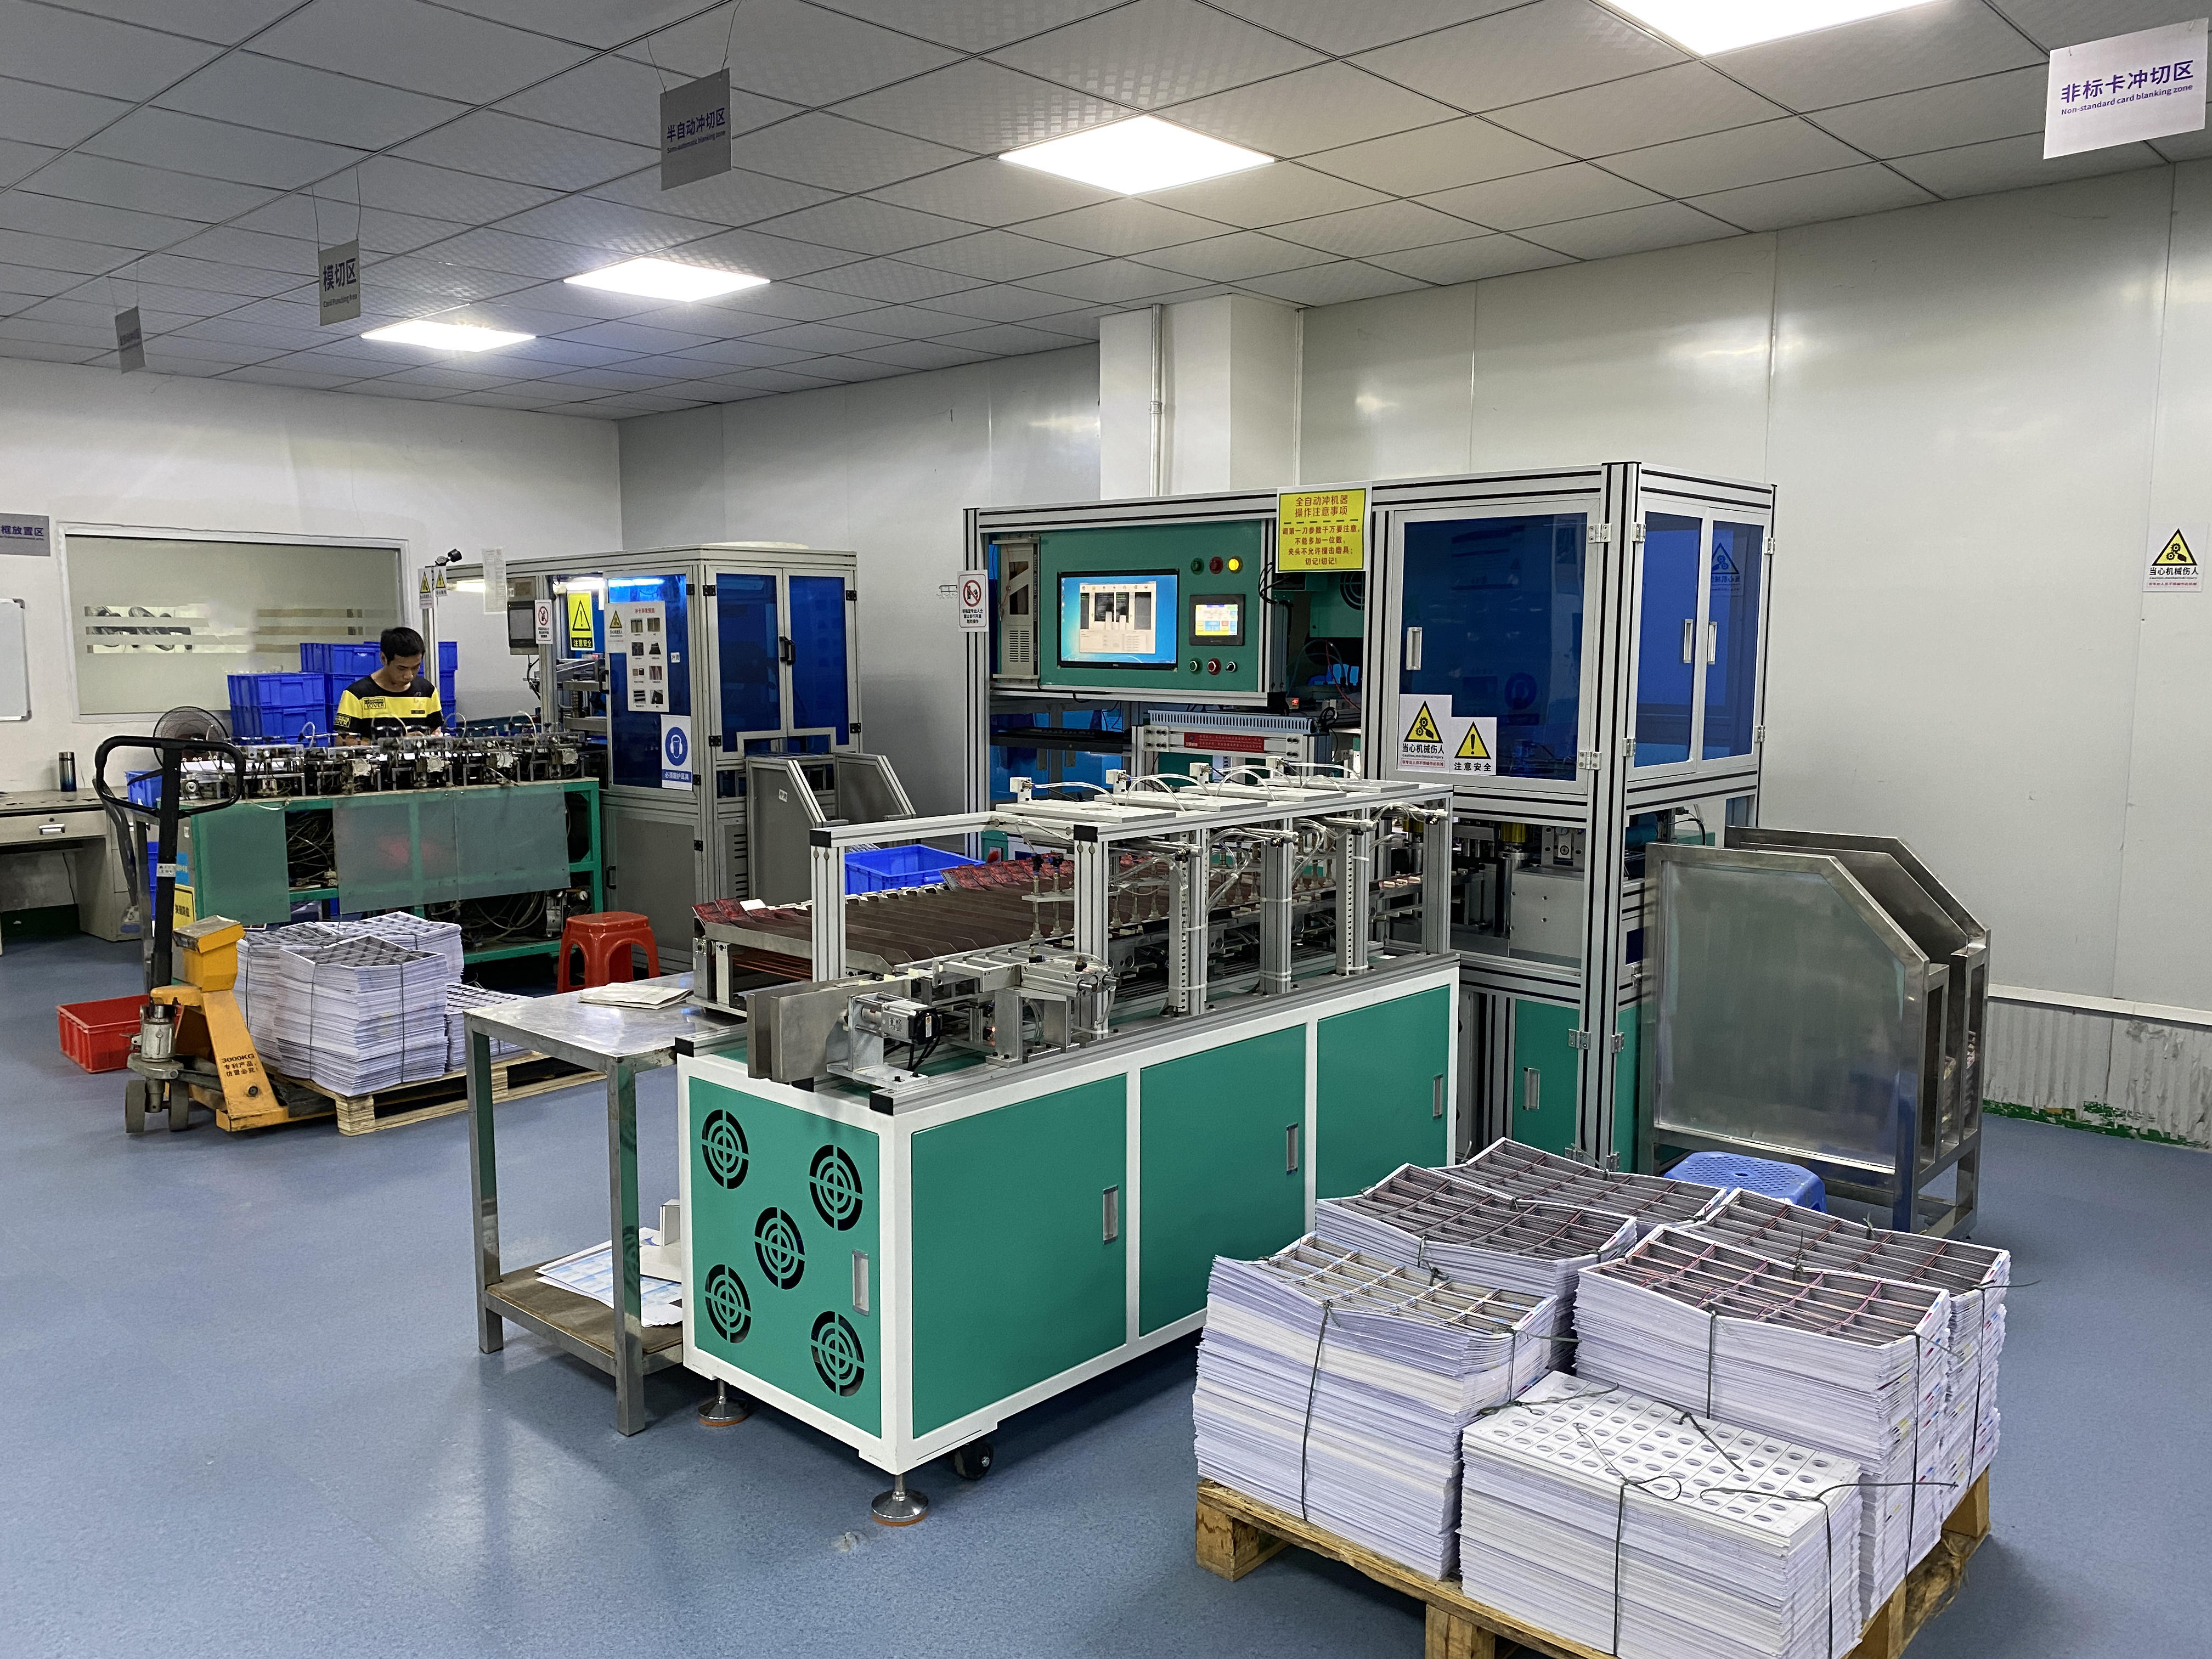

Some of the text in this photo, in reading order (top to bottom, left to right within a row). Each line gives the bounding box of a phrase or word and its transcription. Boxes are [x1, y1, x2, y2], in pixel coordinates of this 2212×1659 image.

[2061, 60, 2193, 103] 非标卡冲切区
[2061, 84, 2193, 115] Non-standard card blanking zone
[667, 108, 725, 142] 半自动冲切区
[323, 258, 357, 292] 模切区
[1295, 494, 1348, 506] 全自动冲机器
[1295, 506, 1348, 518] 操作注意事项
[2149, 567, 2199, 575] 当心机械伤人
[1402, 743, 1445, 754] 当心机械伤人
[1454, 762, 1491, 771] 注意安全
[221, 1053, 255, 1063] 3000KG
